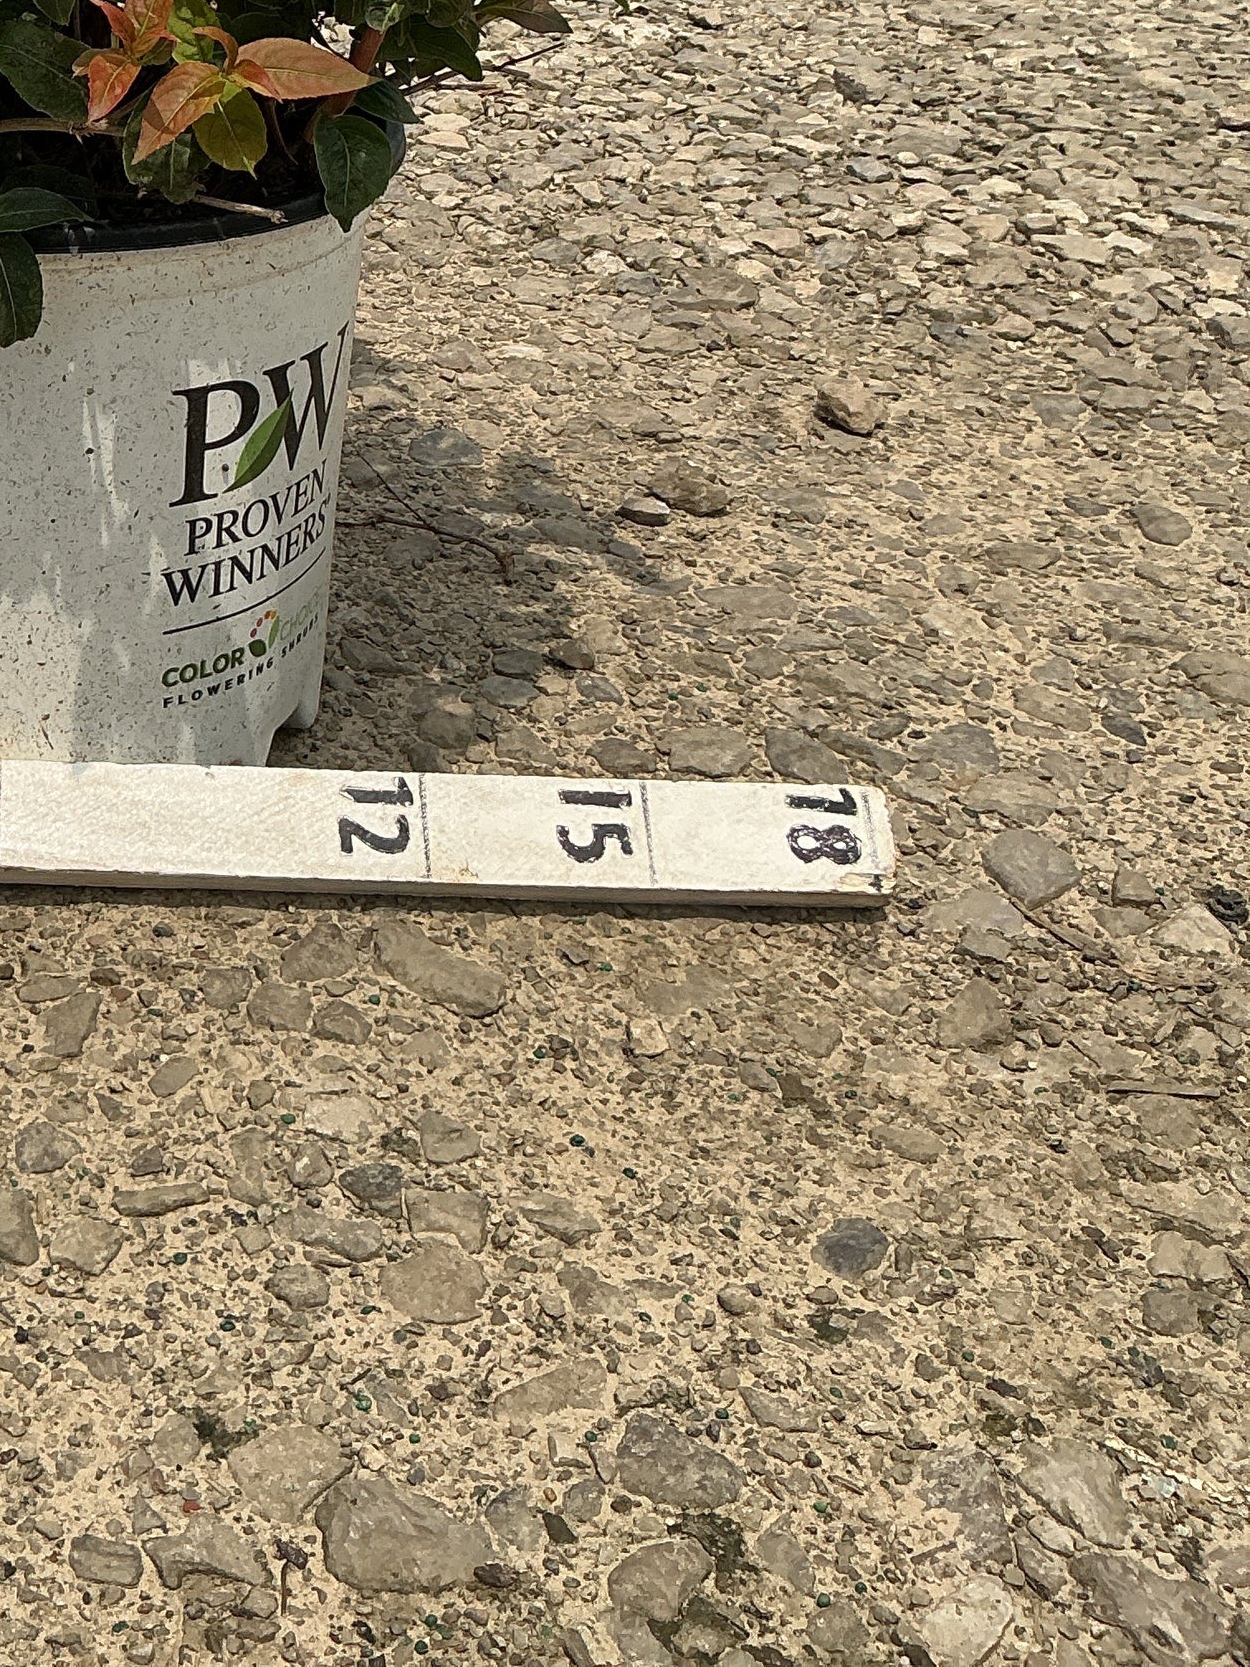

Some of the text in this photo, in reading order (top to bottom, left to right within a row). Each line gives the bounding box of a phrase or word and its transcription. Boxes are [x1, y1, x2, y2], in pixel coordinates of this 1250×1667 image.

[168, 320, 350, 509] PW
[183, 457, 328, 557] PROVEN
[161, 646, 246, 689] COLOR
[161, 656, 275, 710] FLOWERING
[338, 776, 415, 855] 12
[556, 785, 634, 864] 15
[784, 785, 863, 865] 18
